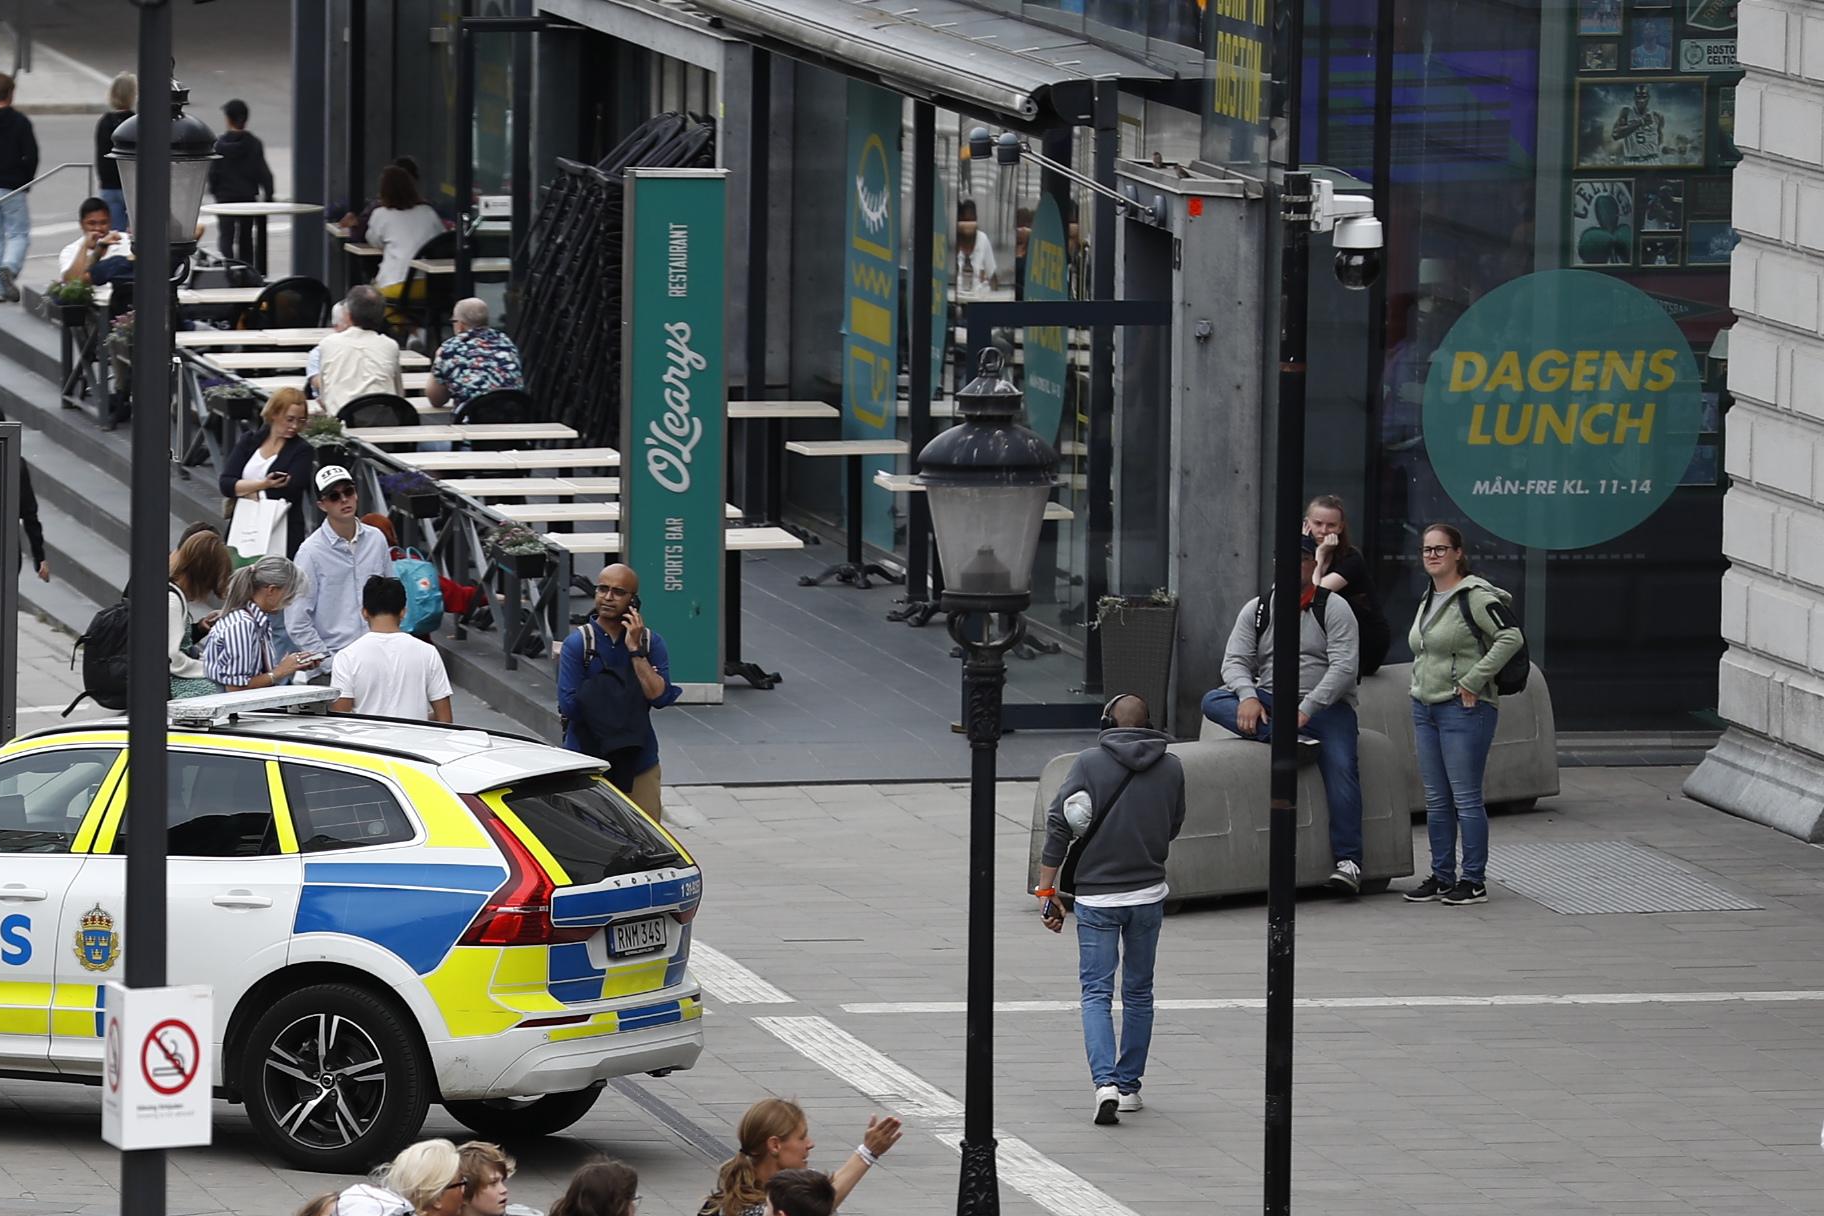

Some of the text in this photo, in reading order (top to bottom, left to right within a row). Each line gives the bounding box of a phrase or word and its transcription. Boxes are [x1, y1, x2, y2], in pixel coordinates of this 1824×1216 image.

[1706, 45, 1737, 54] BOSTO
[1214, 30, 1262, 125] BOSTON
[668, 222, 688, 298] RESTAURANT
[1030, 239, 1064, 294] AFTER
[1448, 349, 1678, 393] DAGENS
[646, 320, 707, 493] O'Learys
[1467, 403, 1657, 446] LUNCH
[1472, 476, 1652, 495] MÅN-FRE KL. 11-14
[664, 517, 684, 592] SPORTS BAR
[613, 870, 677, 888] VOLVO
[617, 923, 641, 950] RNM
